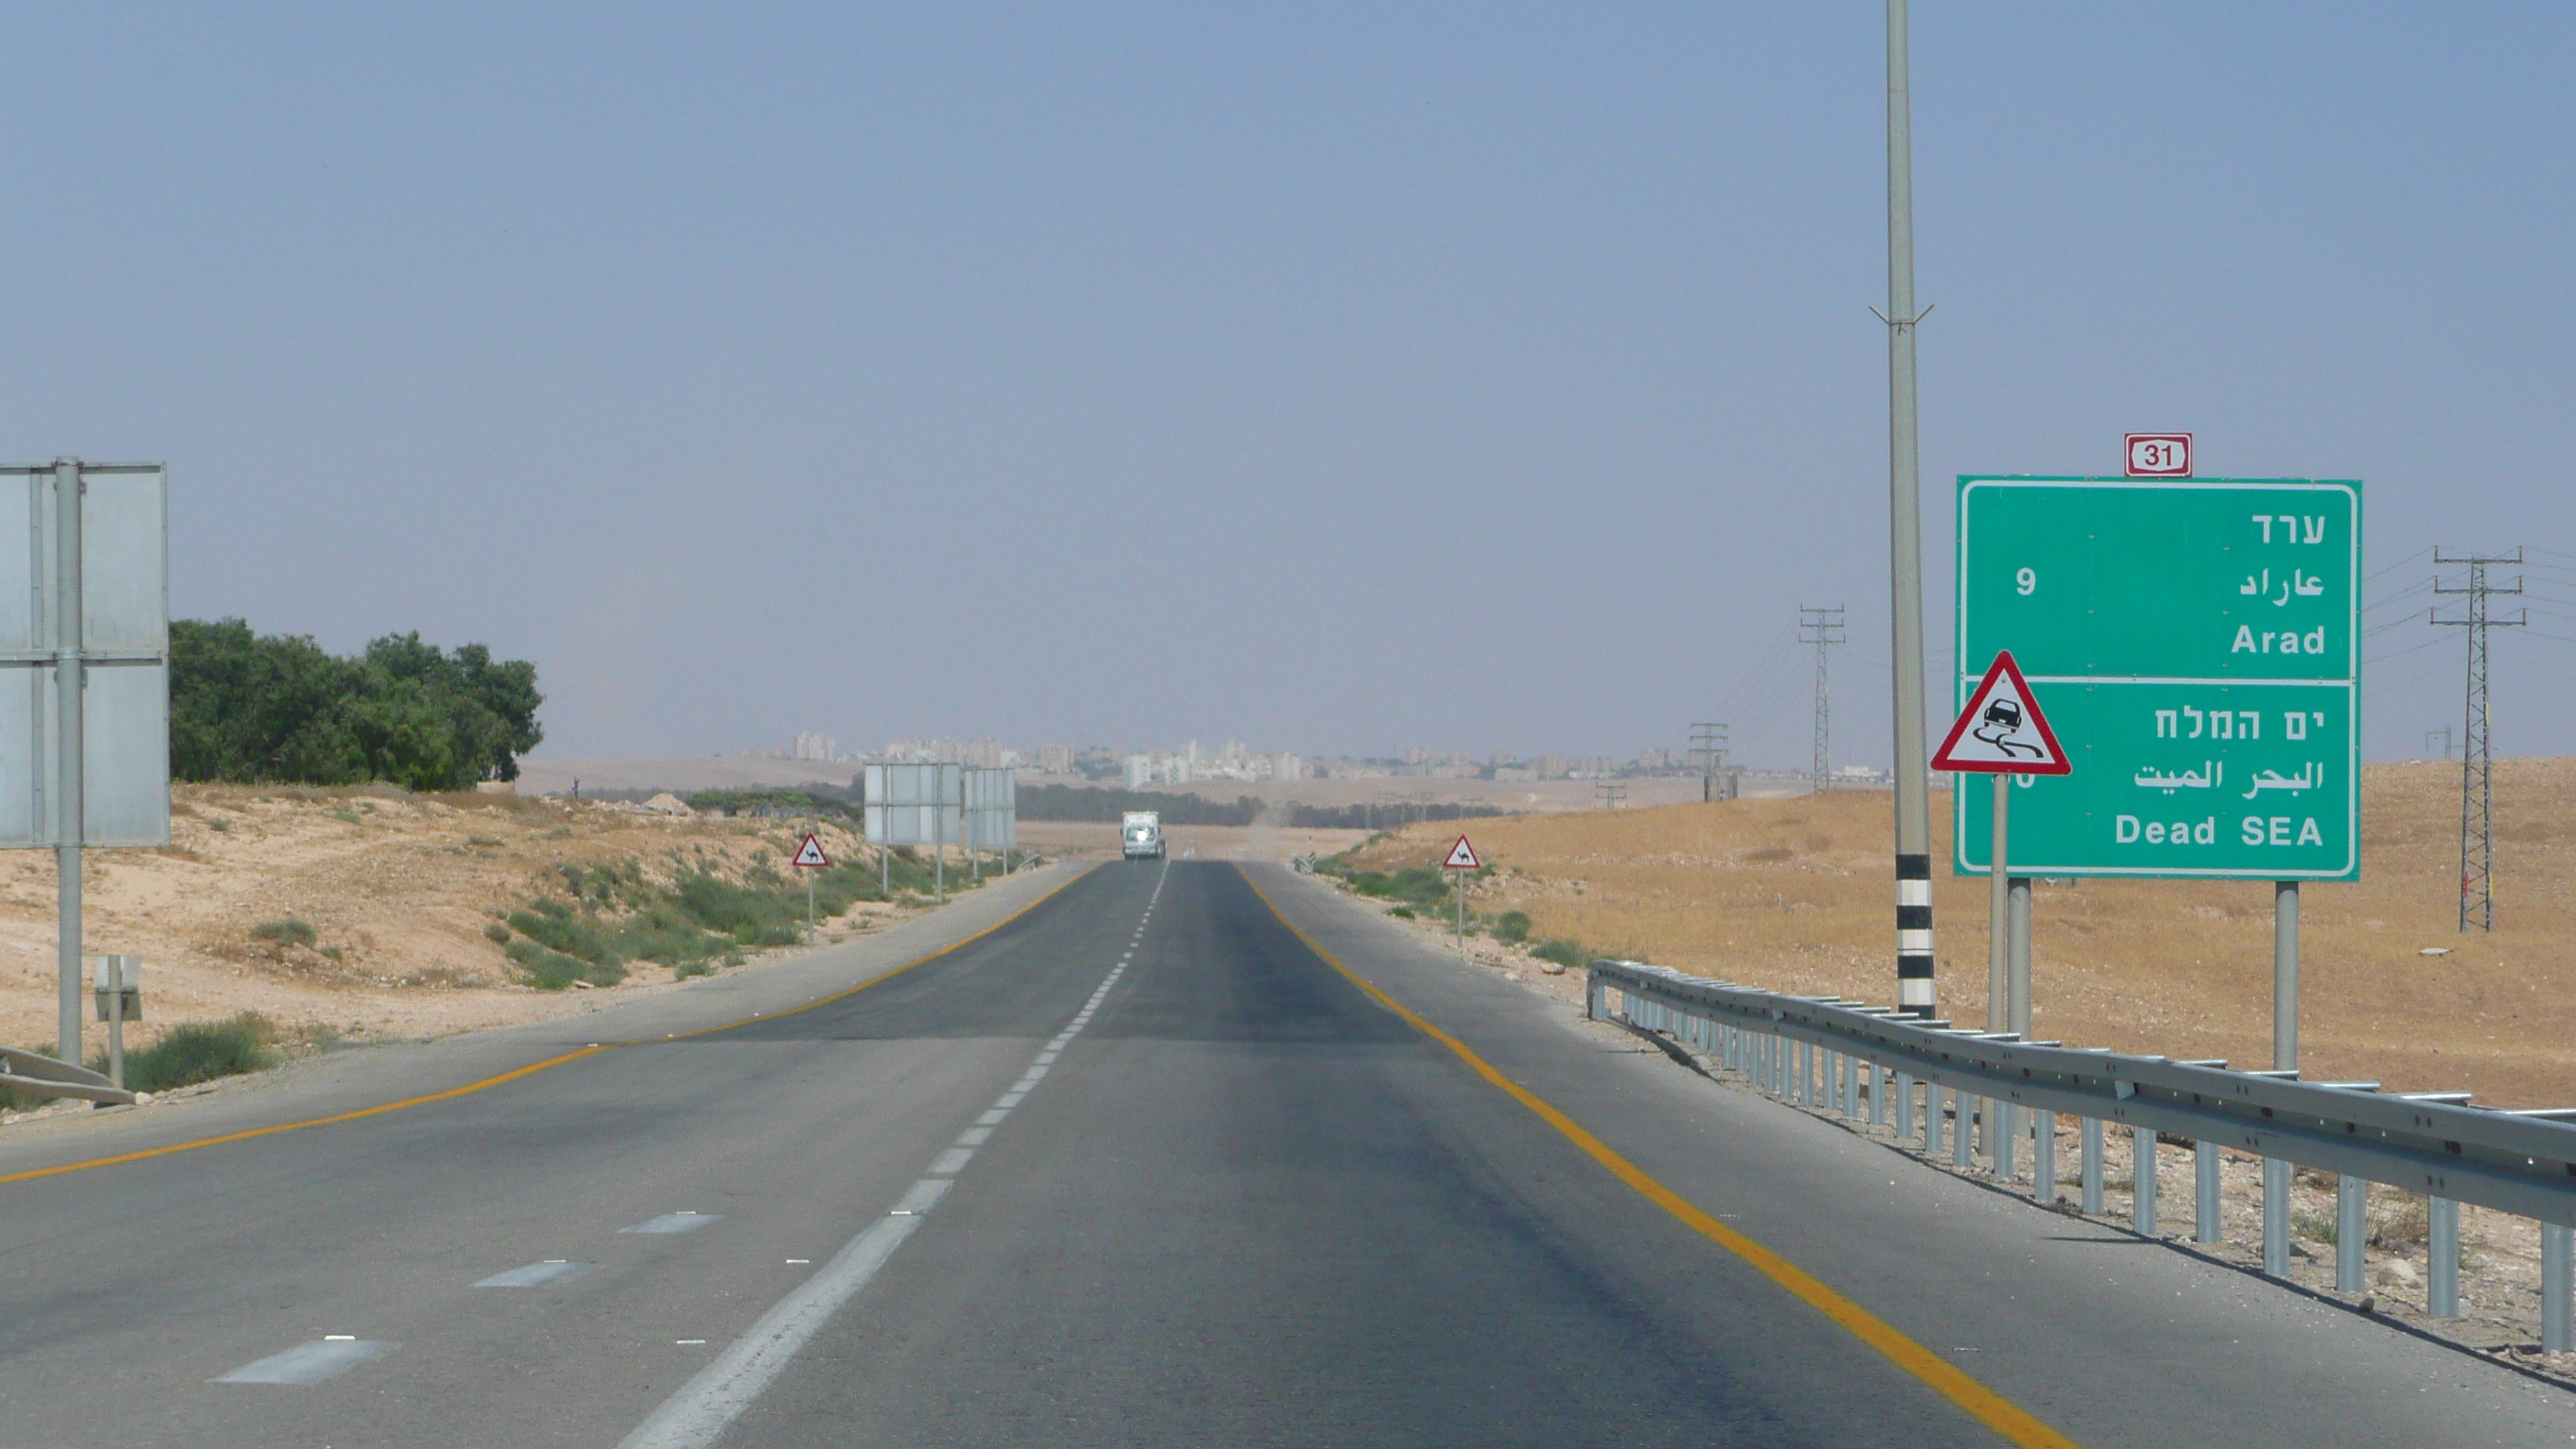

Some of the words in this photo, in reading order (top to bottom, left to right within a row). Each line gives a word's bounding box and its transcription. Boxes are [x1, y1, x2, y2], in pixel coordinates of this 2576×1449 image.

[2144, 444, 2173, 467] 31
[2252, 515, 2325, 544] ערד
[2016, 567, 2036, 596] 9
[2240, 568, 2324, 607] عاراد
[2231, 625, 2325, 654] Arad
[2155, 704, 2260, 739] המלח
[2284, 711, 2324, 740] ים
[2134, 760, 2223, 795] الميت
[2242, 761, 2324, 800] البحر
[2116, 814, 2215, 844] Dead
[2242, 816, 2324, 846] SEA
